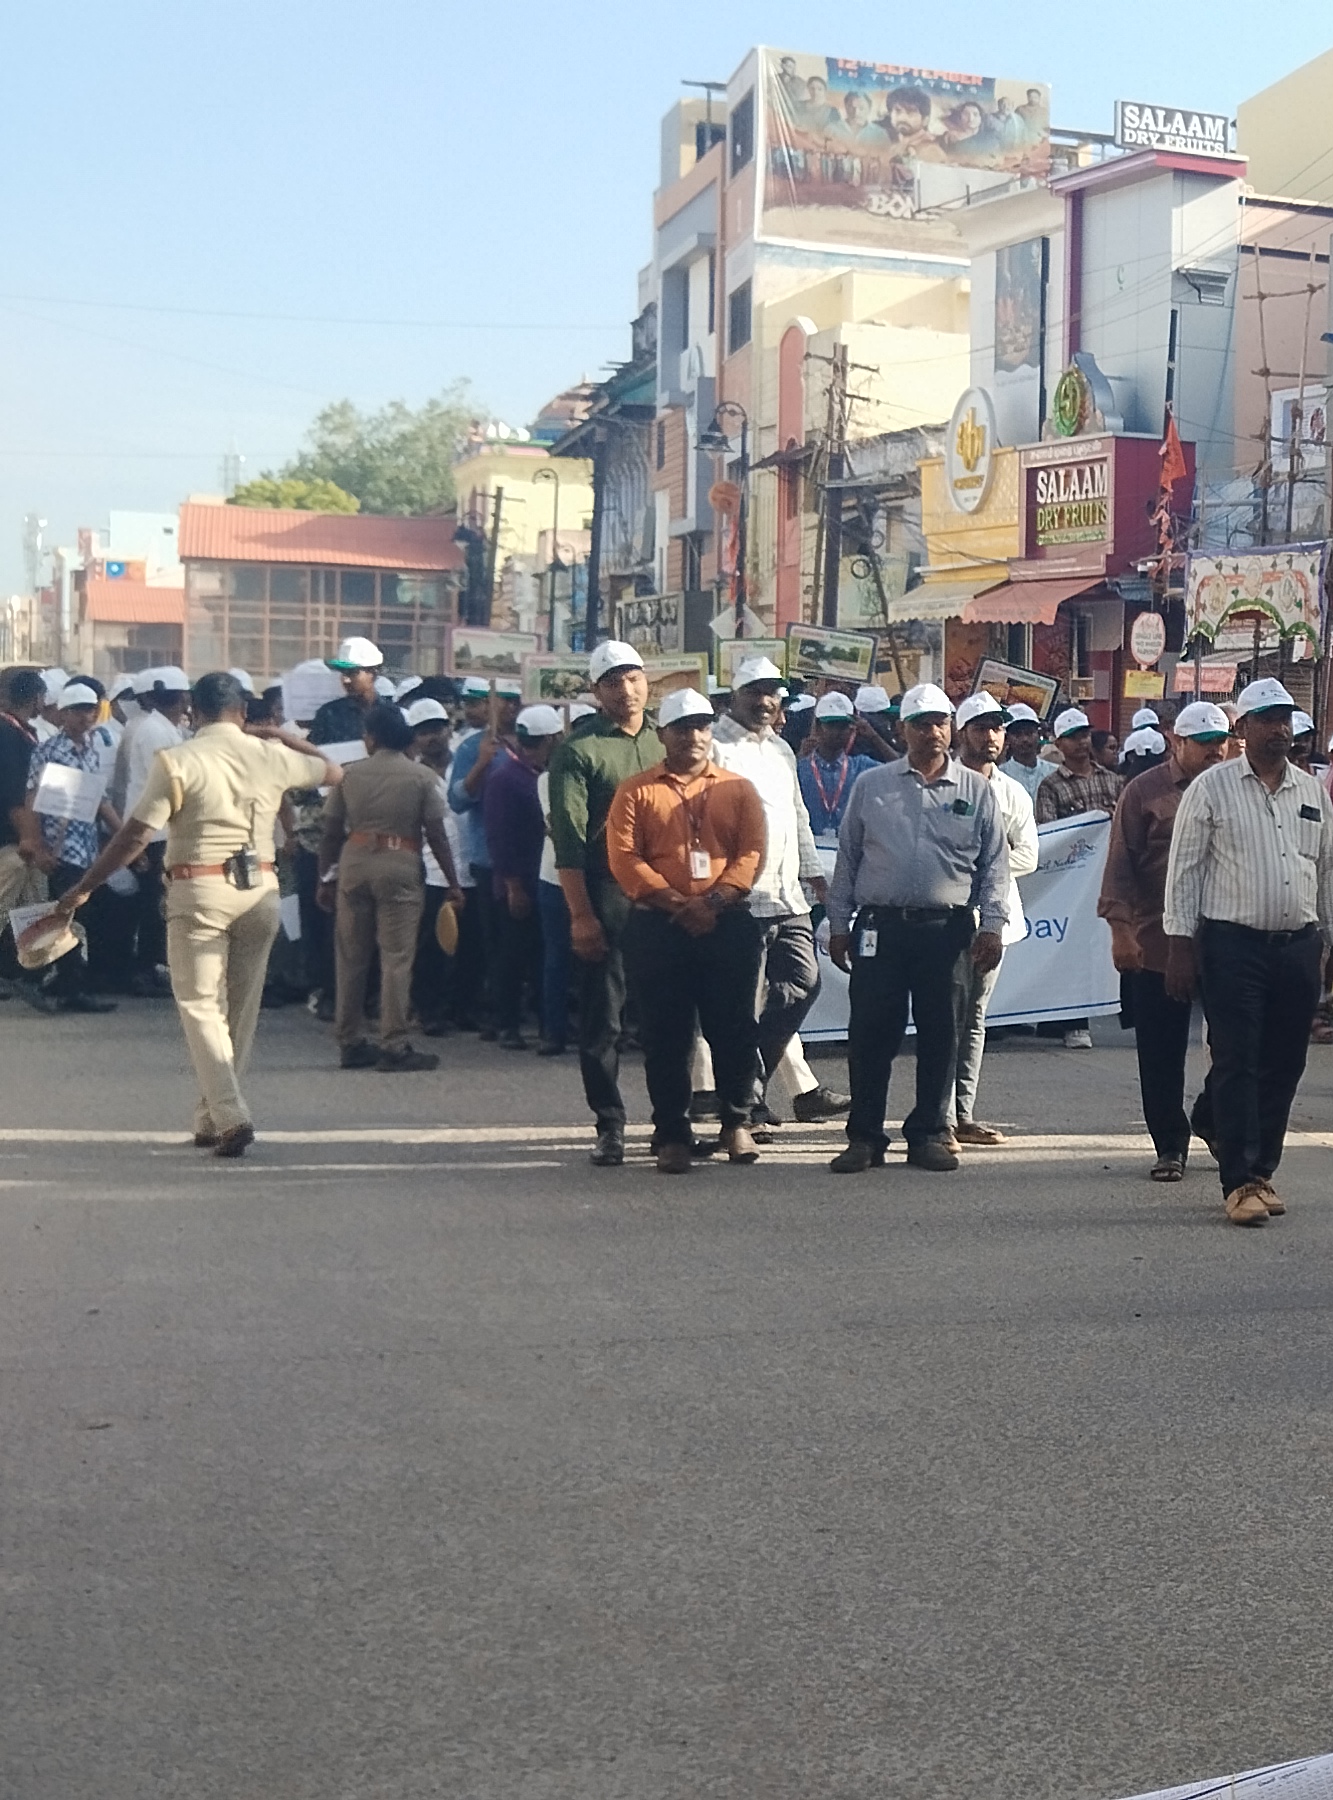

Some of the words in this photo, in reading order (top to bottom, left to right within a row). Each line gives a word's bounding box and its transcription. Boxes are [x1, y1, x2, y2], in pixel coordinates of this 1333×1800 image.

[1124, 105, 1225, 141] SALAAM
[1124, 129, 1160, 145] DRY
[1164, 134, 1225, 154] FRUITS
[1036, 464, 1108, 504] SALAAM
[1037, 505, 1060, 531] DRY
[1063, 500, 1108, 529] FRUITS
